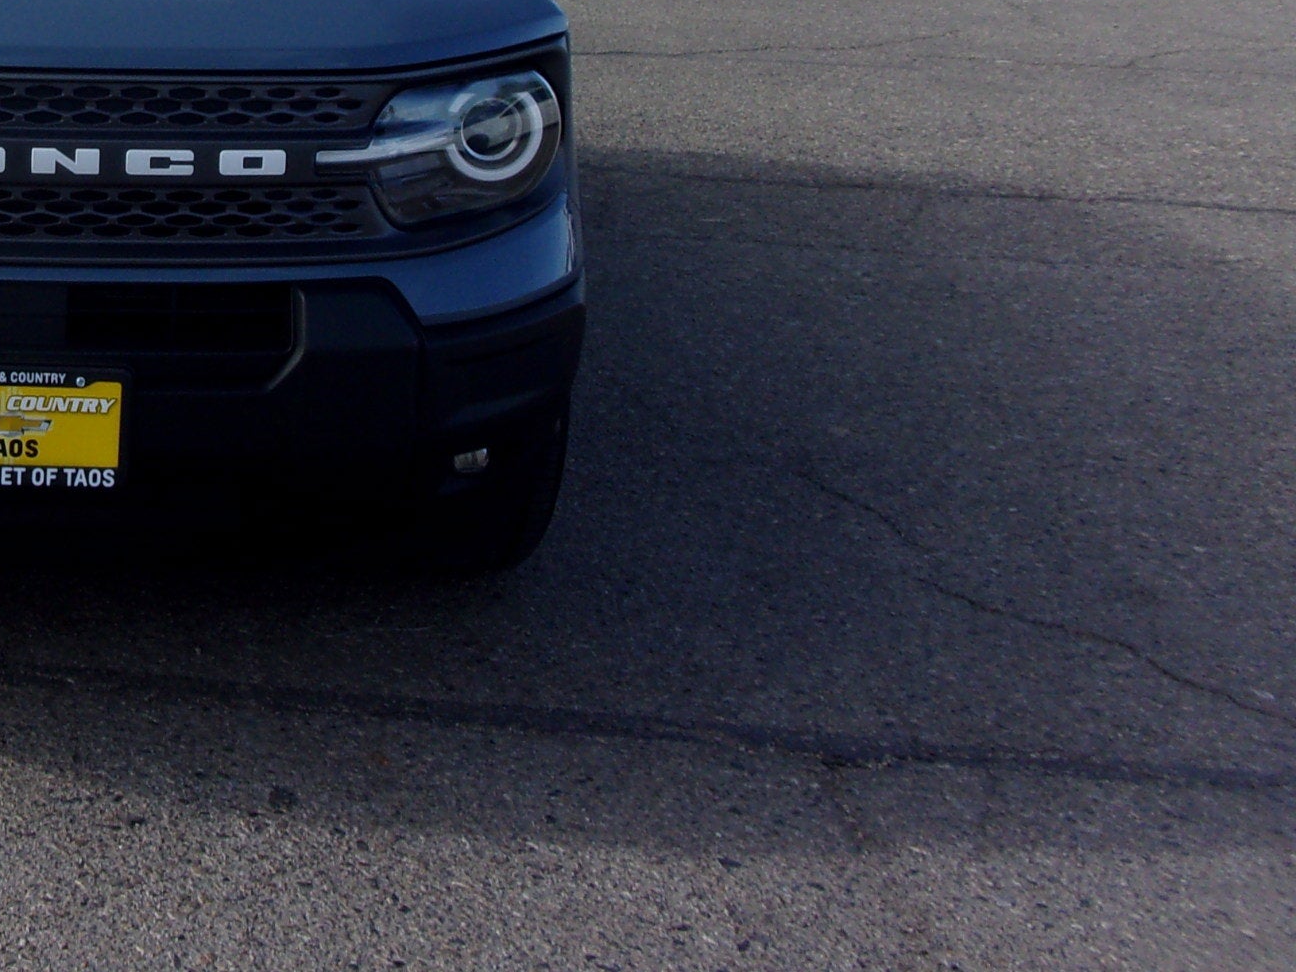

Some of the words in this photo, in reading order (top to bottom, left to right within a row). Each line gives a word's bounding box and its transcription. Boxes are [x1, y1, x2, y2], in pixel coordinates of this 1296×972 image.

[10, 371, 67, 385] COUNTRY
[6, 395, 117, 414] COUNTRY
[32, 467, 59, 487] OF
[63, 468, 116, 488] TAOS
